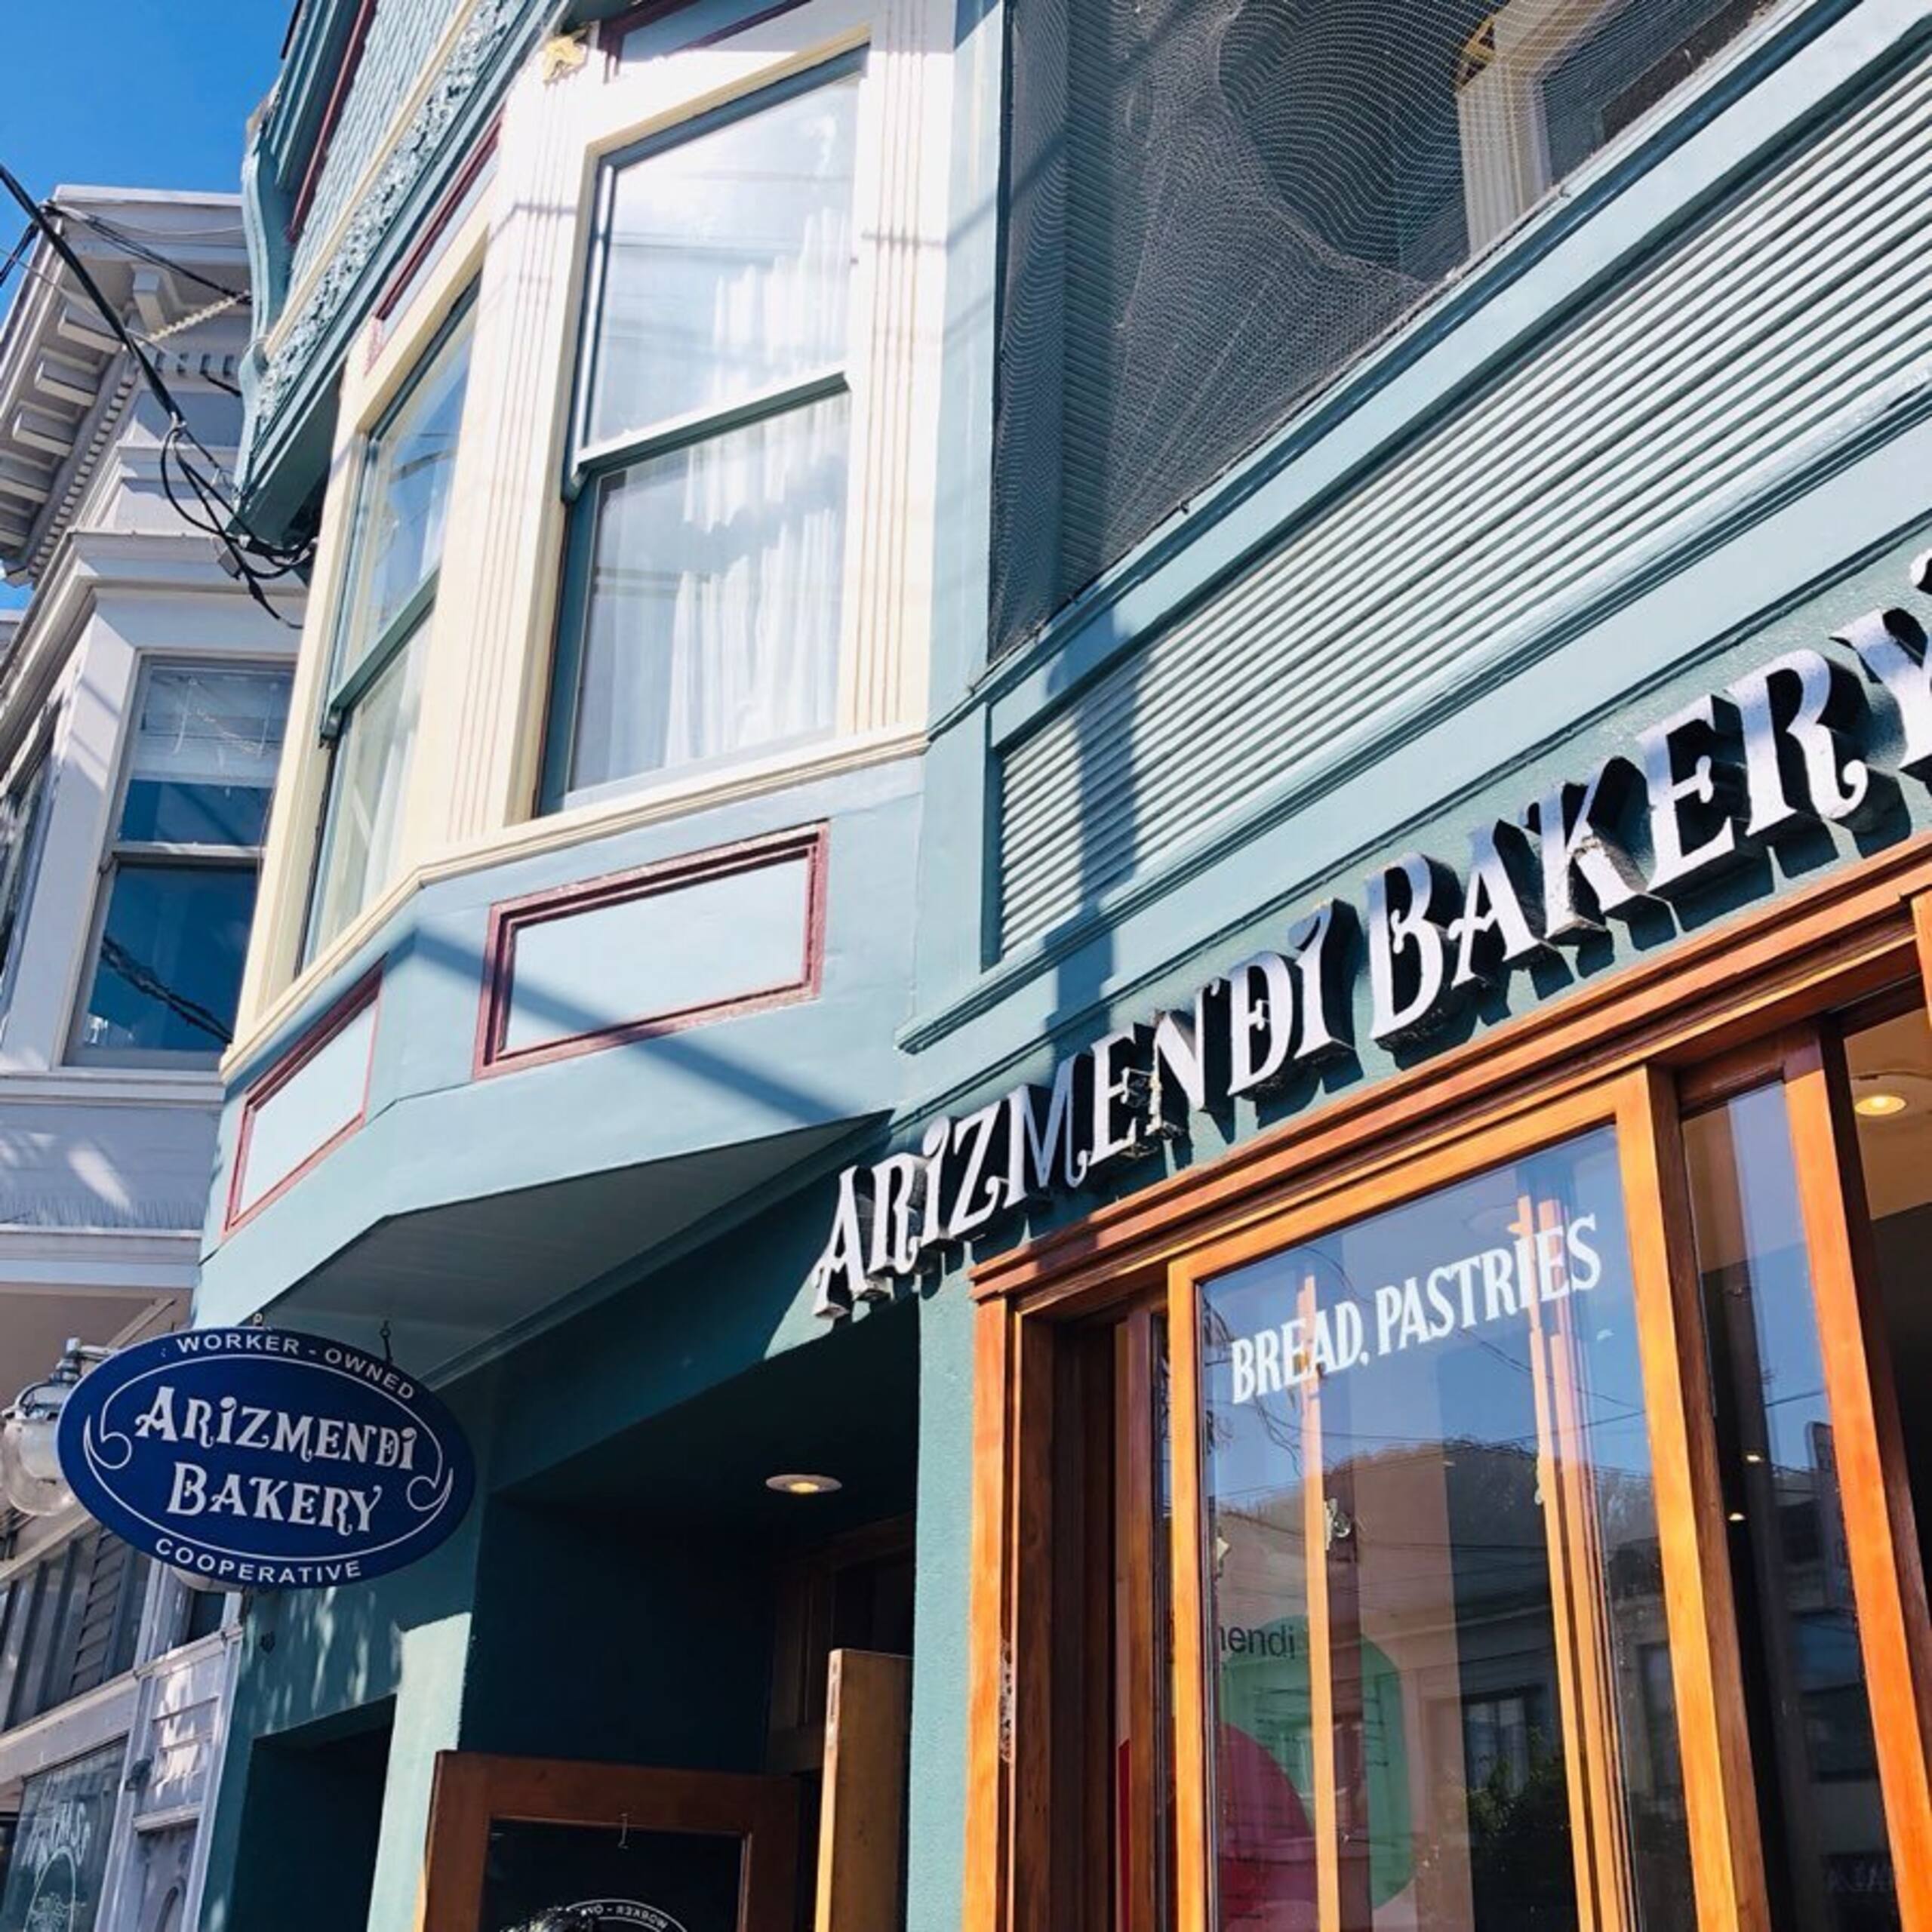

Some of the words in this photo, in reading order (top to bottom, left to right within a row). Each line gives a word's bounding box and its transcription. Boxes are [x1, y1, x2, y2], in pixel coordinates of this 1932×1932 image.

[813, 901, 1336, 1318] ARIZMENDI
[1375, 1212, 1603, 1355] PASTRIES
[176, 1333, 300, 1355] WORKER
[325, 1347, 415, 1399] OWNED
[135, 1386, 417, 1472] ARIZMENDI
[166, 1460, 383, 1537] BAKERY
[155, 1537, 362, 1584] COOPERATIVE
